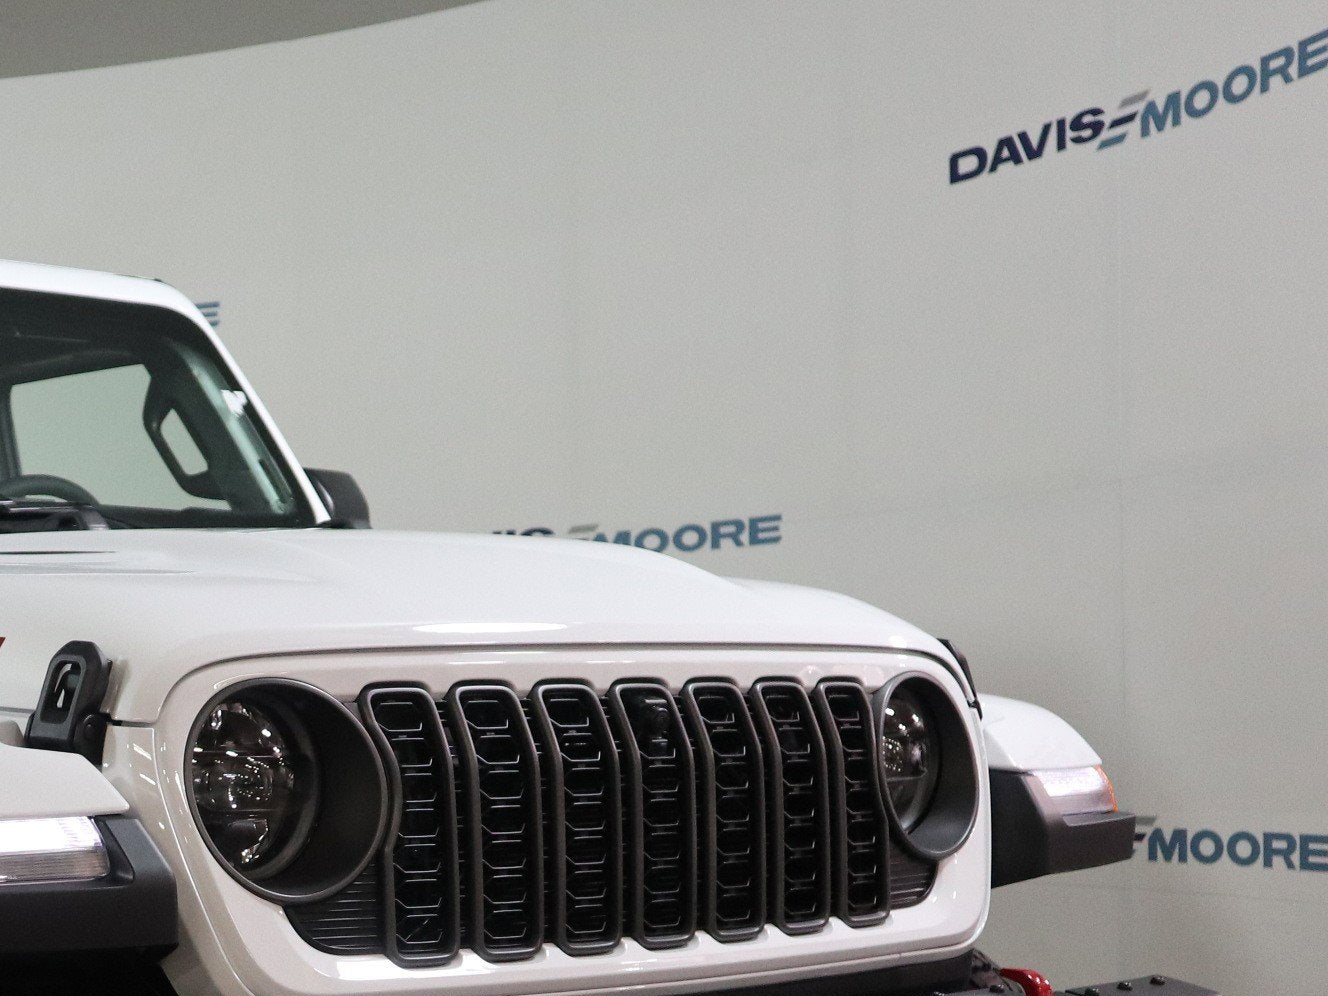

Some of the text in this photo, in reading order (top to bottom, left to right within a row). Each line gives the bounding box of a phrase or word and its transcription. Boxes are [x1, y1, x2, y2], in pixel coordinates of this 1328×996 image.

[948, 27, 1328, 186] DAVIS MOORE
[1146, 827, 1328, 873] MOORE
